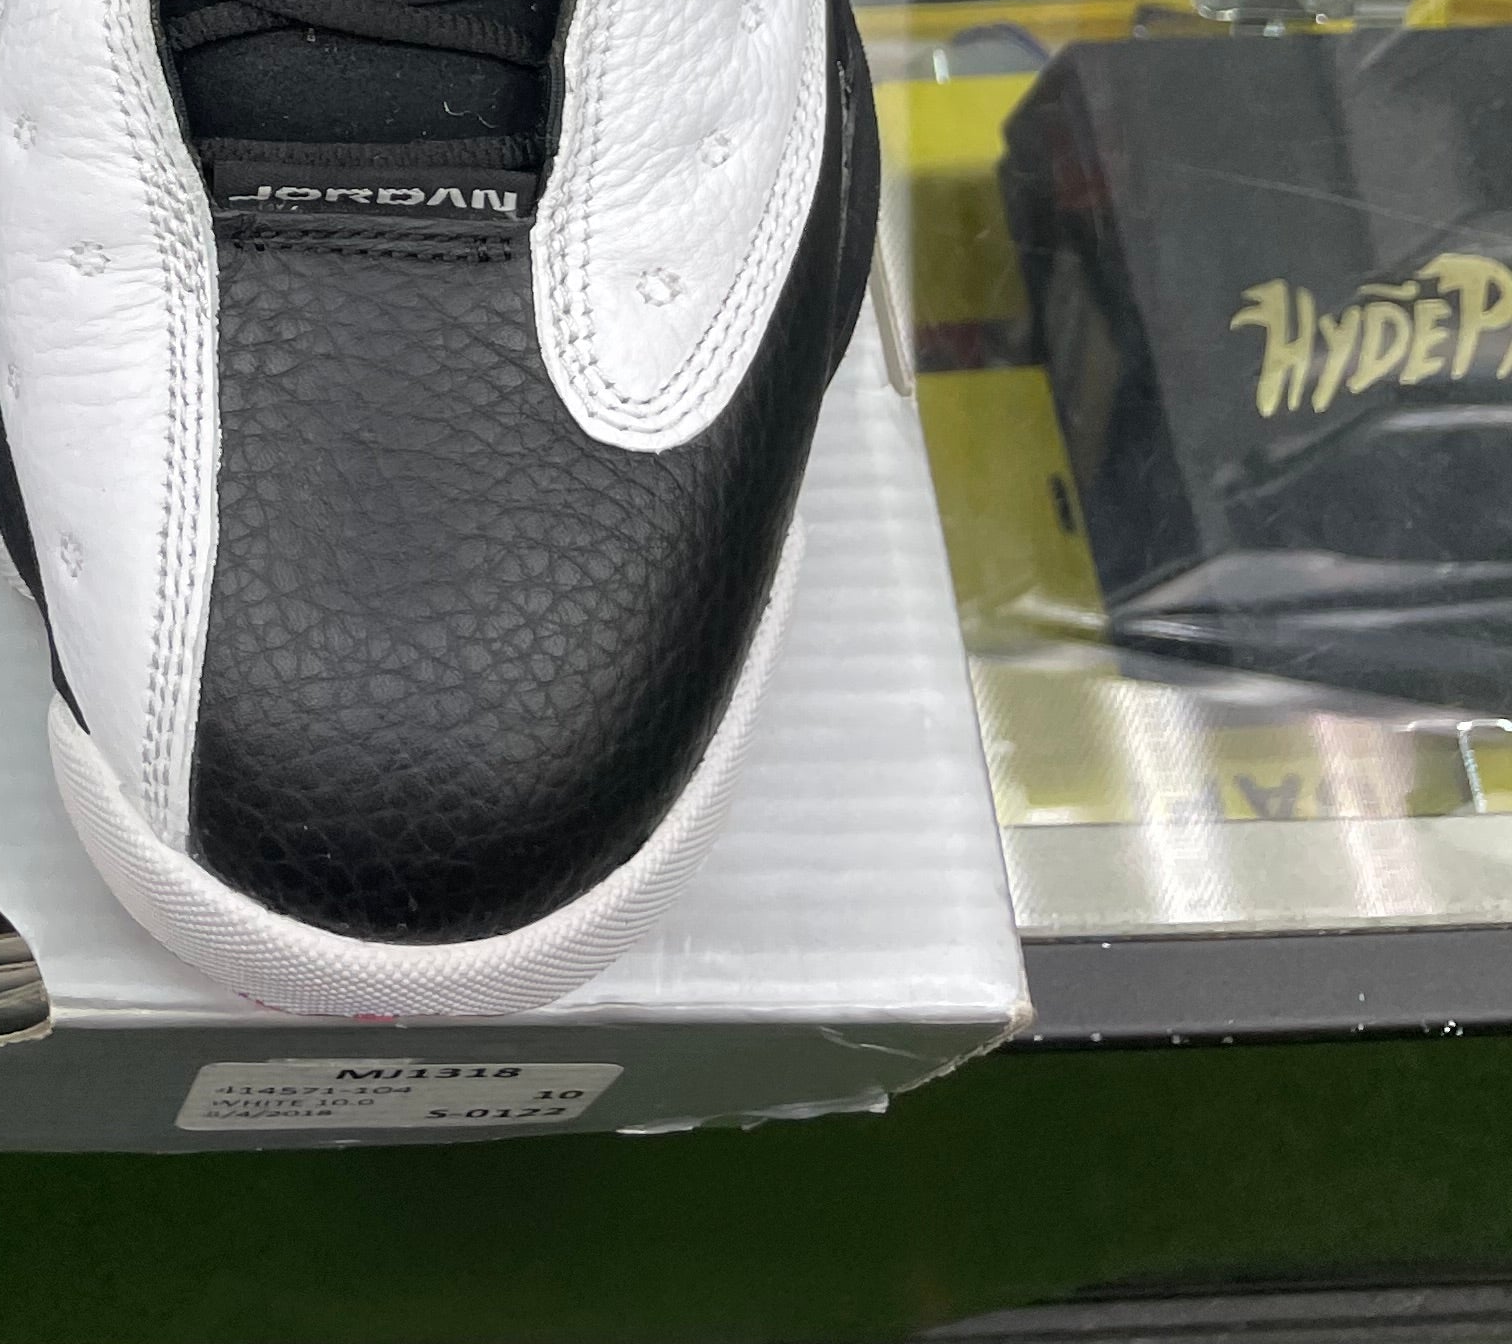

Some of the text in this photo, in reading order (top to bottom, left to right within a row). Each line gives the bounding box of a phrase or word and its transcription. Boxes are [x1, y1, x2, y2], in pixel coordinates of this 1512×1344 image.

[228, 186, 517, 211] JORDAN
[336, 1067, 522, 1079] MJ1318
[215, 1086, 411, 1095] 414571-104
[534, 1090, 584, 1099] 10
[212, 1098, 304, 1107] WHITE
[425, 1107, 566, 1119] S-0122
